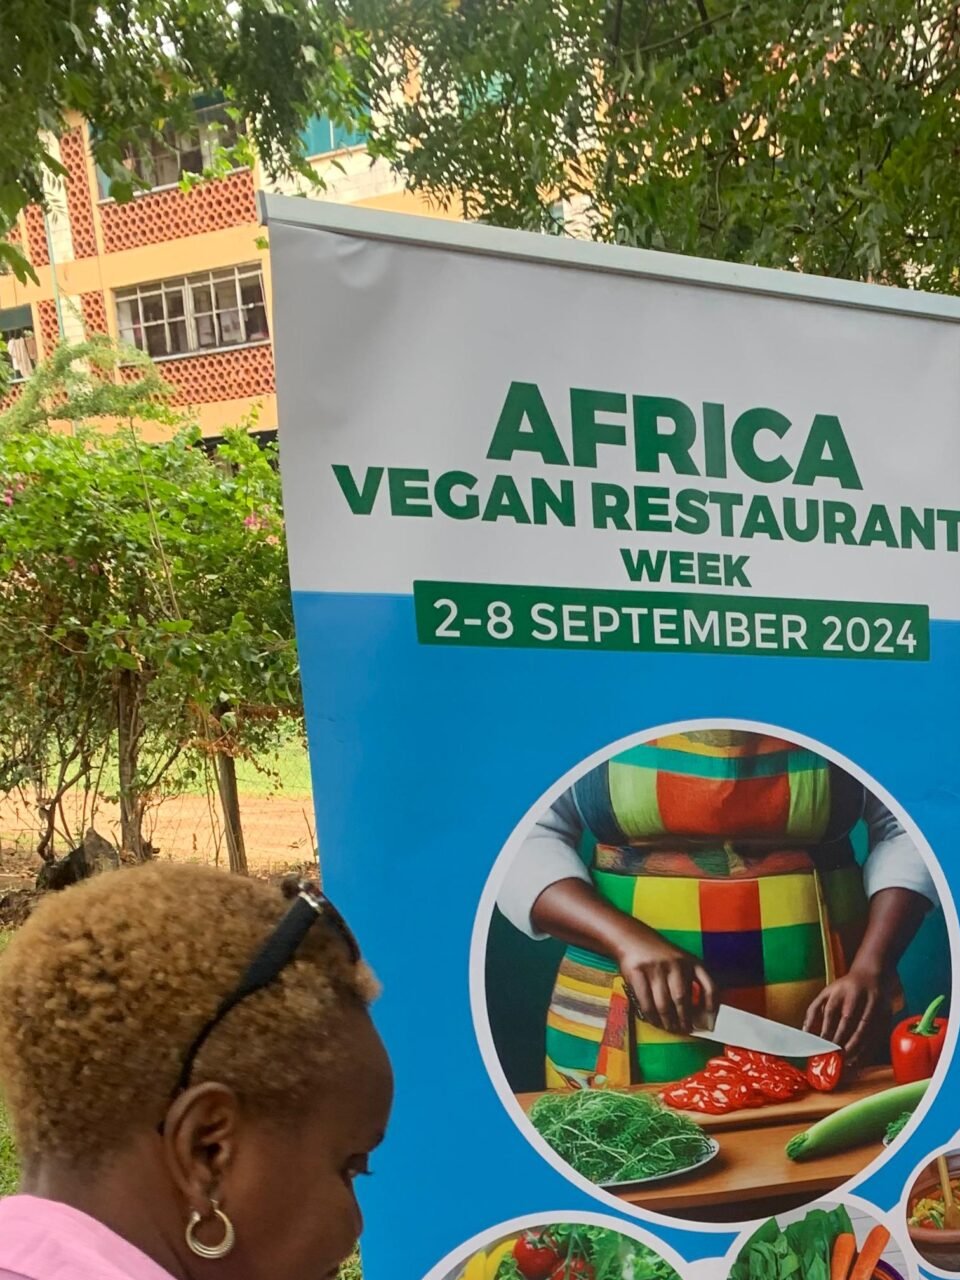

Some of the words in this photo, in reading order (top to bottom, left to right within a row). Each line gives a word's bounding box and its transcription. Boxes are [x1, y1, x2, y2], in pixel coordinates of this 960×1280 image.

[486, 380, 863, 490] AFRICA
[331, 464, 577, 528] VEGAN
[619, 548, 753, 588] WEEK
[433, 598, 514, 640] 2-8
[530, 602, 809, 652] SEPTEMBER
[822, 615, 918, 654] 2024
